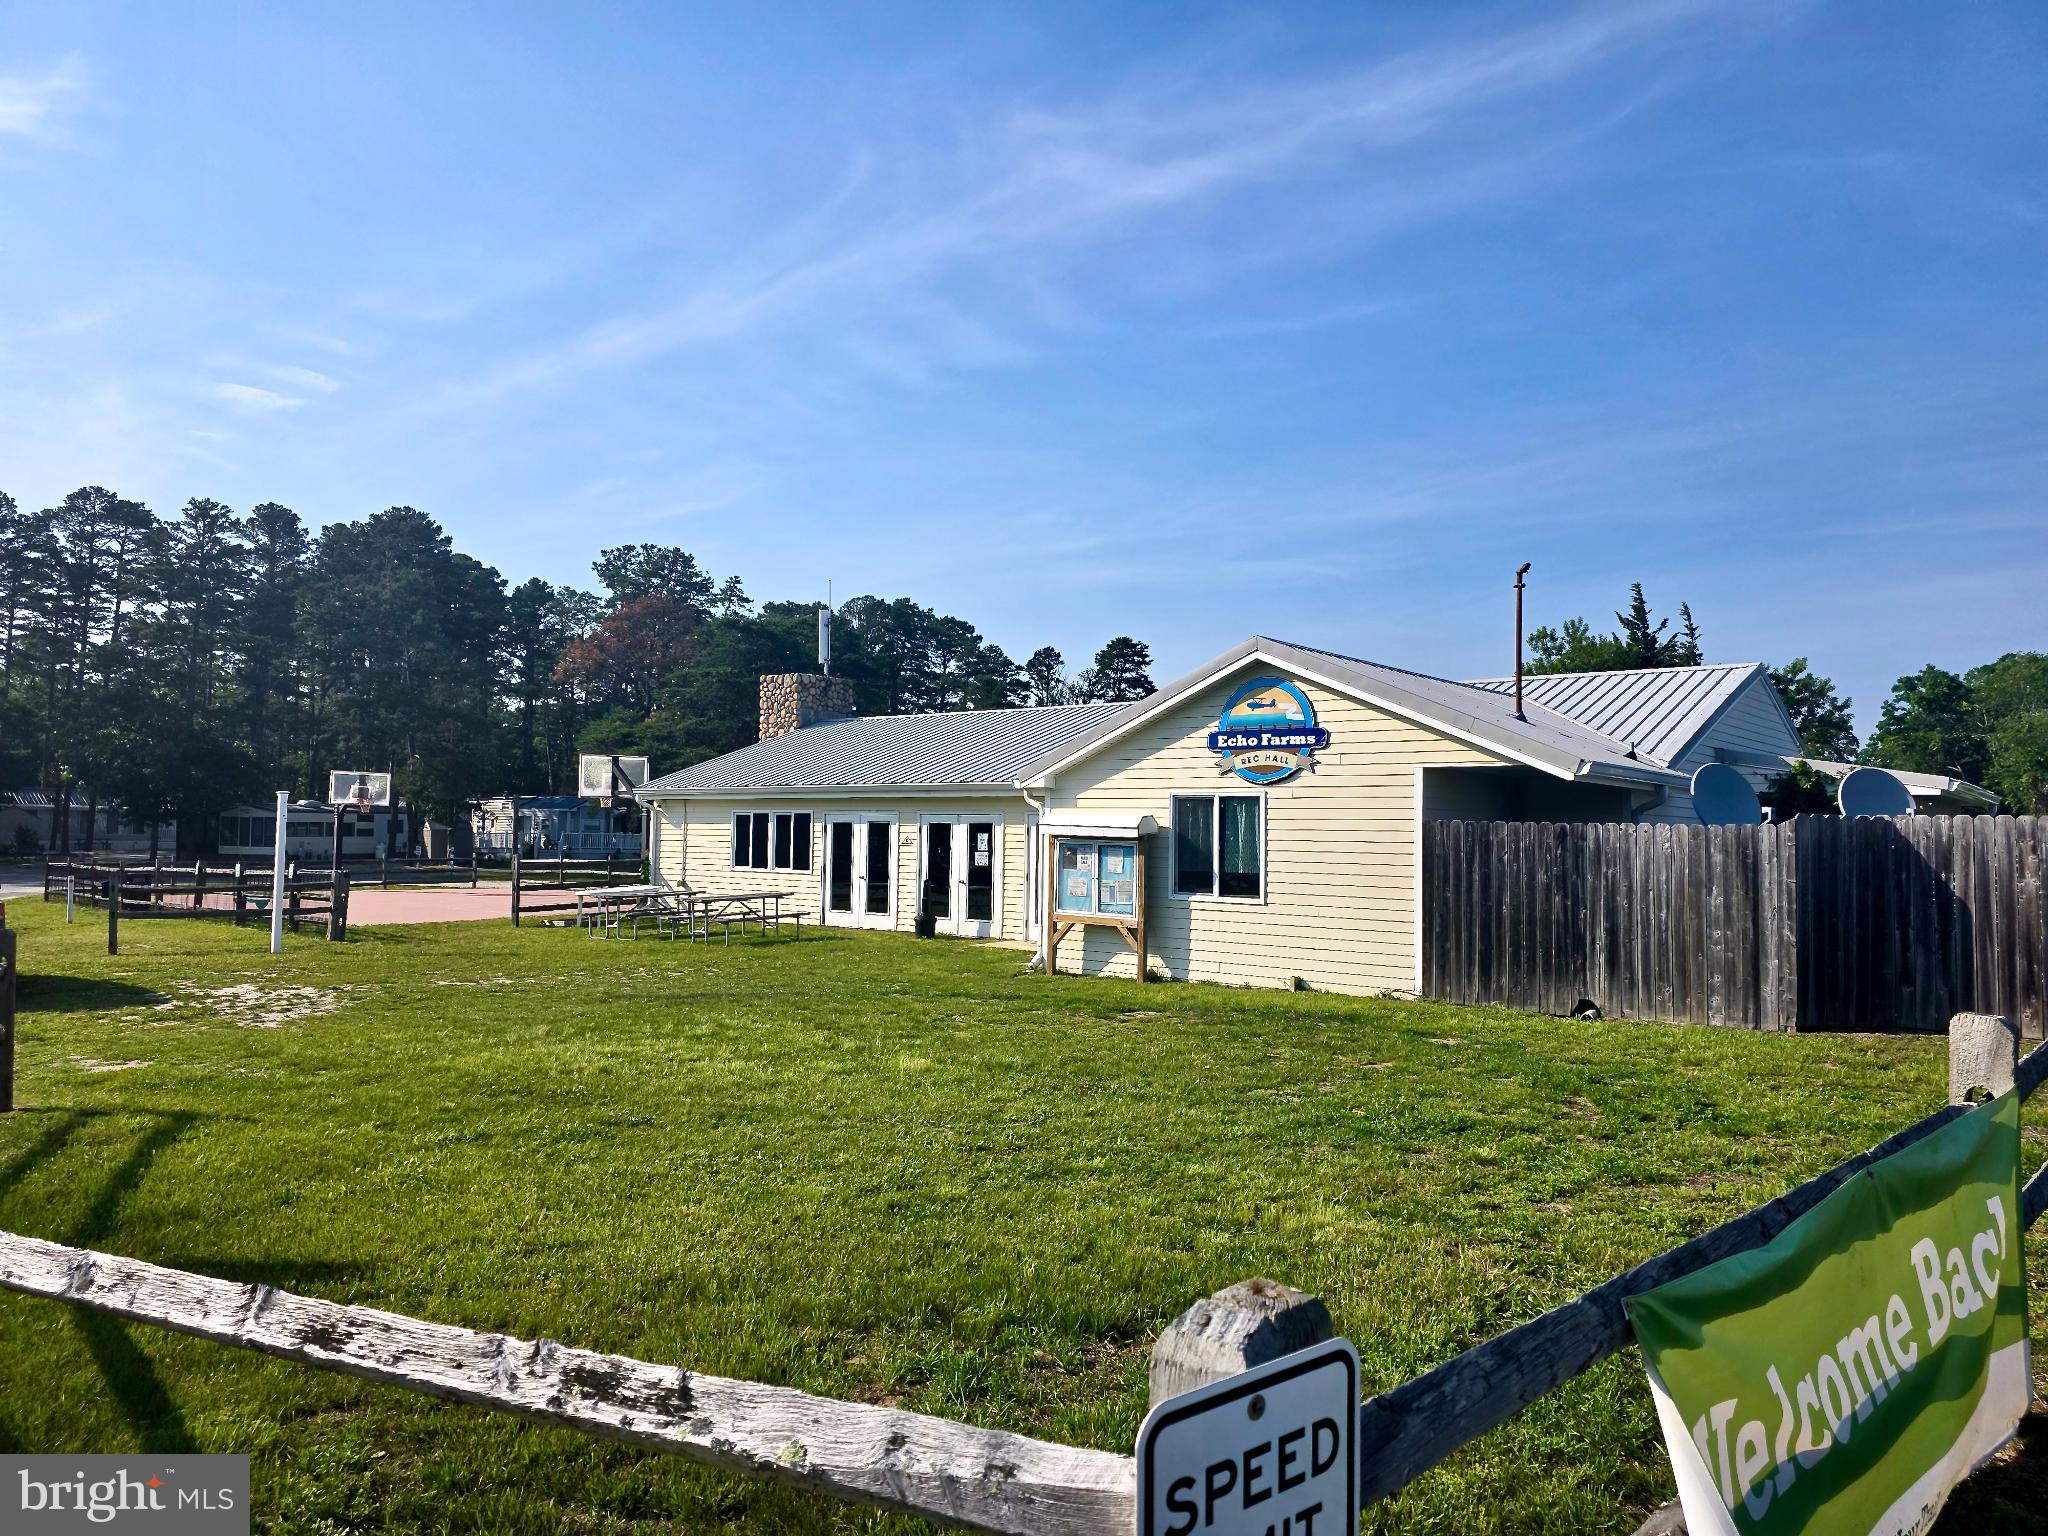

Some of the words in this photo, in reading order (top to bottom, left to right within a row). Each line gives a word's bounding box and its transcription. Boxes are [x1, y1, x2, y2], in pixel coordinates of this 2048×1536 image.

[1217, 735, 1258, 748] Echo
[1260, 733, 1316, 746] Farms
[1241, 755, 1259, 765] REC
[1264, 754, 1289, 765] HALL
[1164, 1417, 1340, 1536] SPEED
